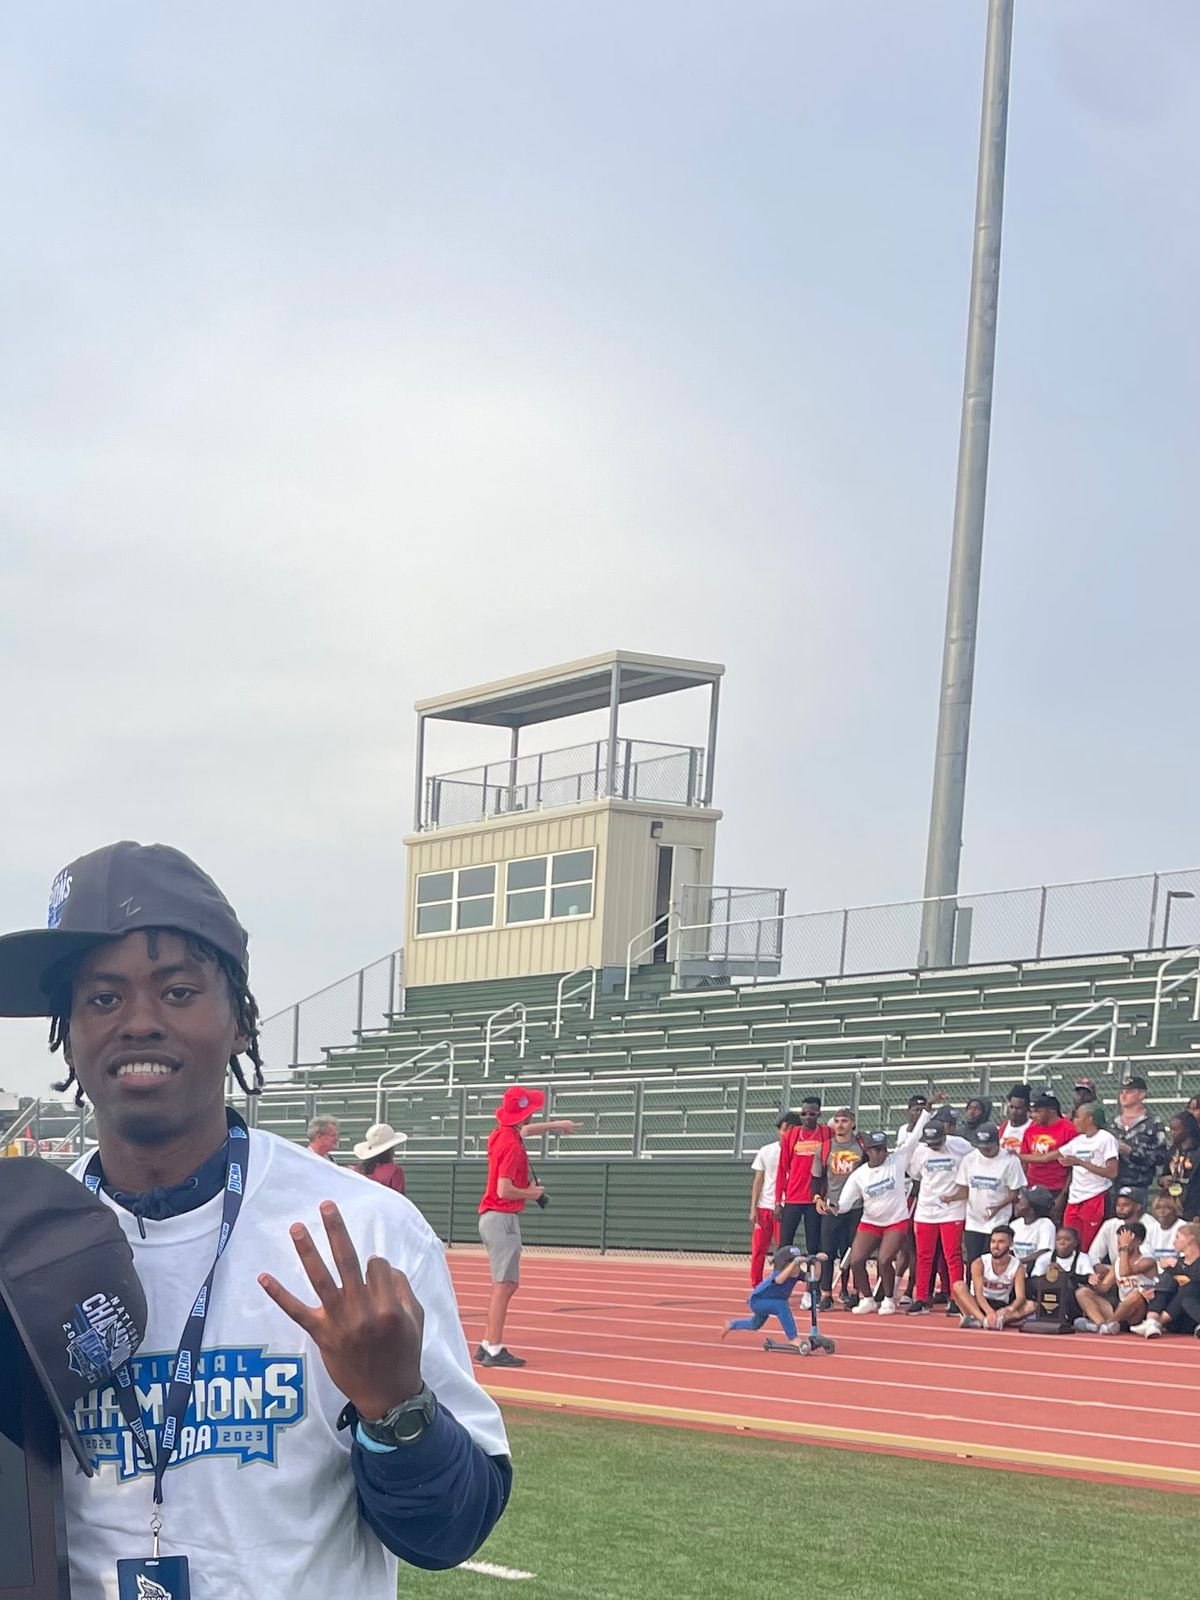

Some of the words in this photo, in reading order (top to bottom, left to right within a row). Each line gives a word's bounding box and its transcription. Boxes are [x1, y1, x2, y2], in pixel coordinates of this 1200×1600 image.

[227, 1163, 242, 1194] NJCAA
[175, 1351, 191, 1384] NJCAA
[73, 1363, 298, 1431] HAMIONS
[85, 1439, 112, 1449] 2022
[163, 1416, 176, 1449] NJCAA
[223, 1431, 263, 1442] 2023
[122, 1424, 211, 1475] NJAA
